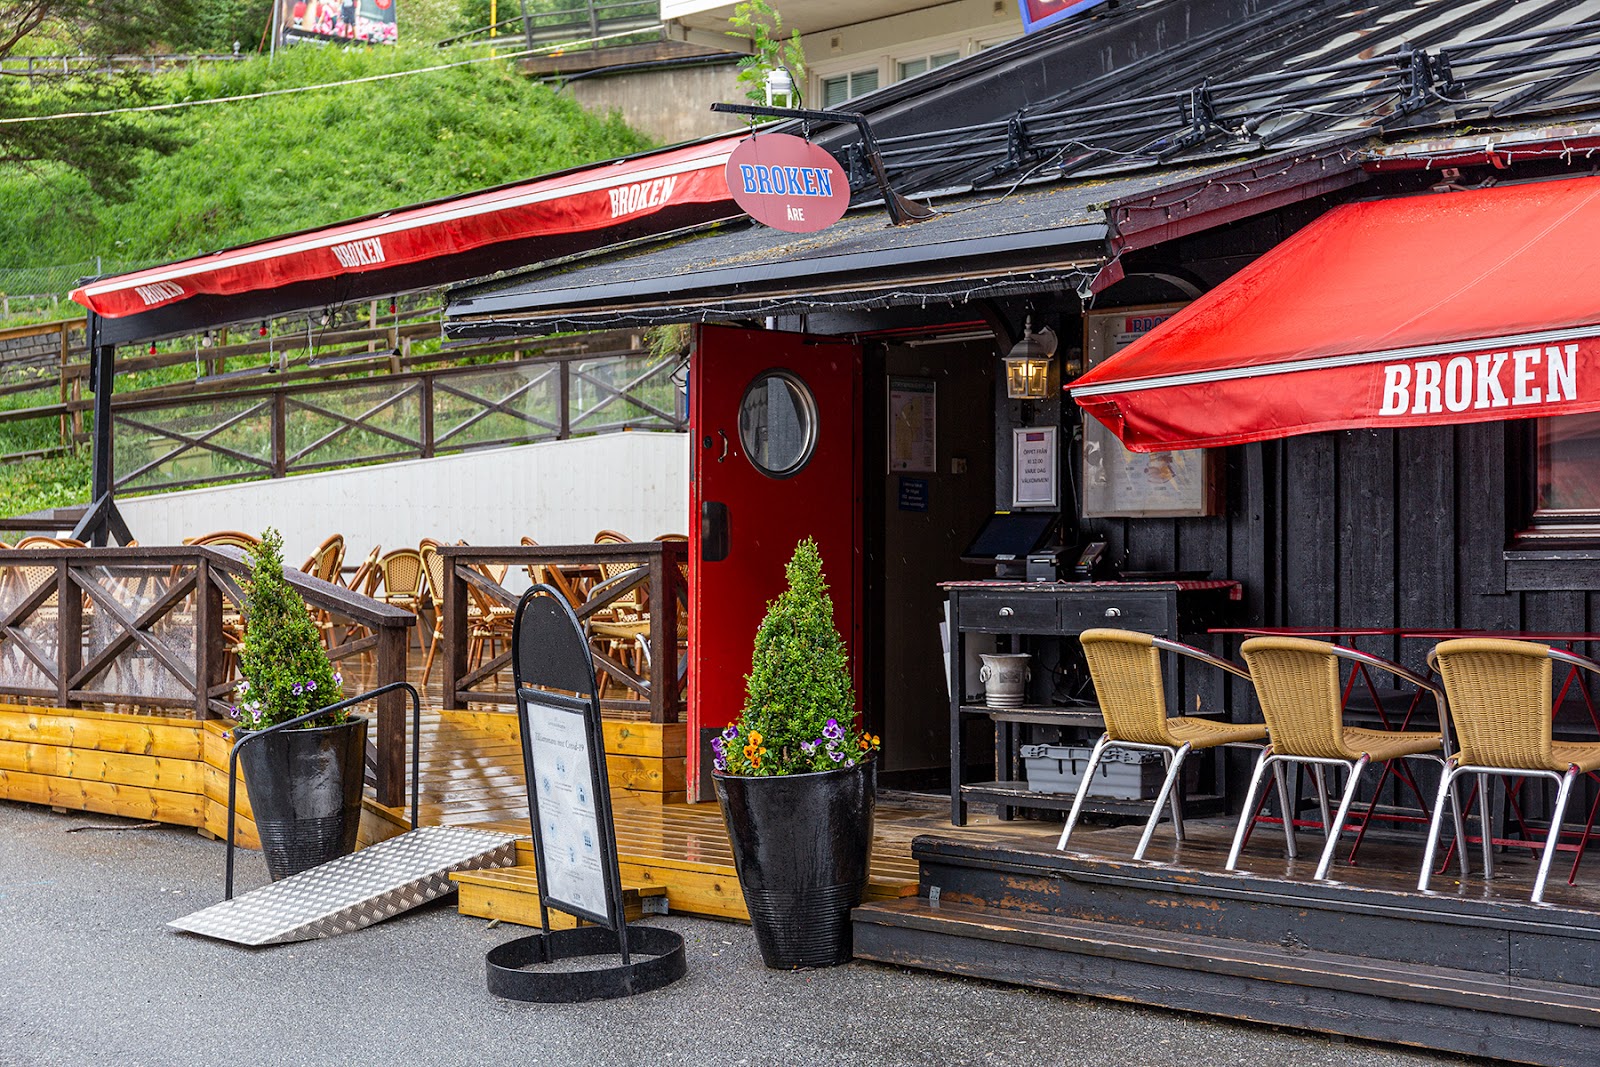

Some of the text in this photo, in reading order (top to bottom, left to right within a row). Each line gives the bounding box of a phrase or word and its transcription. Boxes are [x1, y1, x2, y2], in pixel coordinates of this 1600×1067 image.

[739, 164, 833, 197] BROKEN
[608, 175, 678, 219] BROKEN
[786, 204, 805, 221] ÅRE
[331, 237, 386, 268] BROKEN
[134, 280, 185, 306] BROKEN
[1378, 343, 1579, 416] BROKEN
